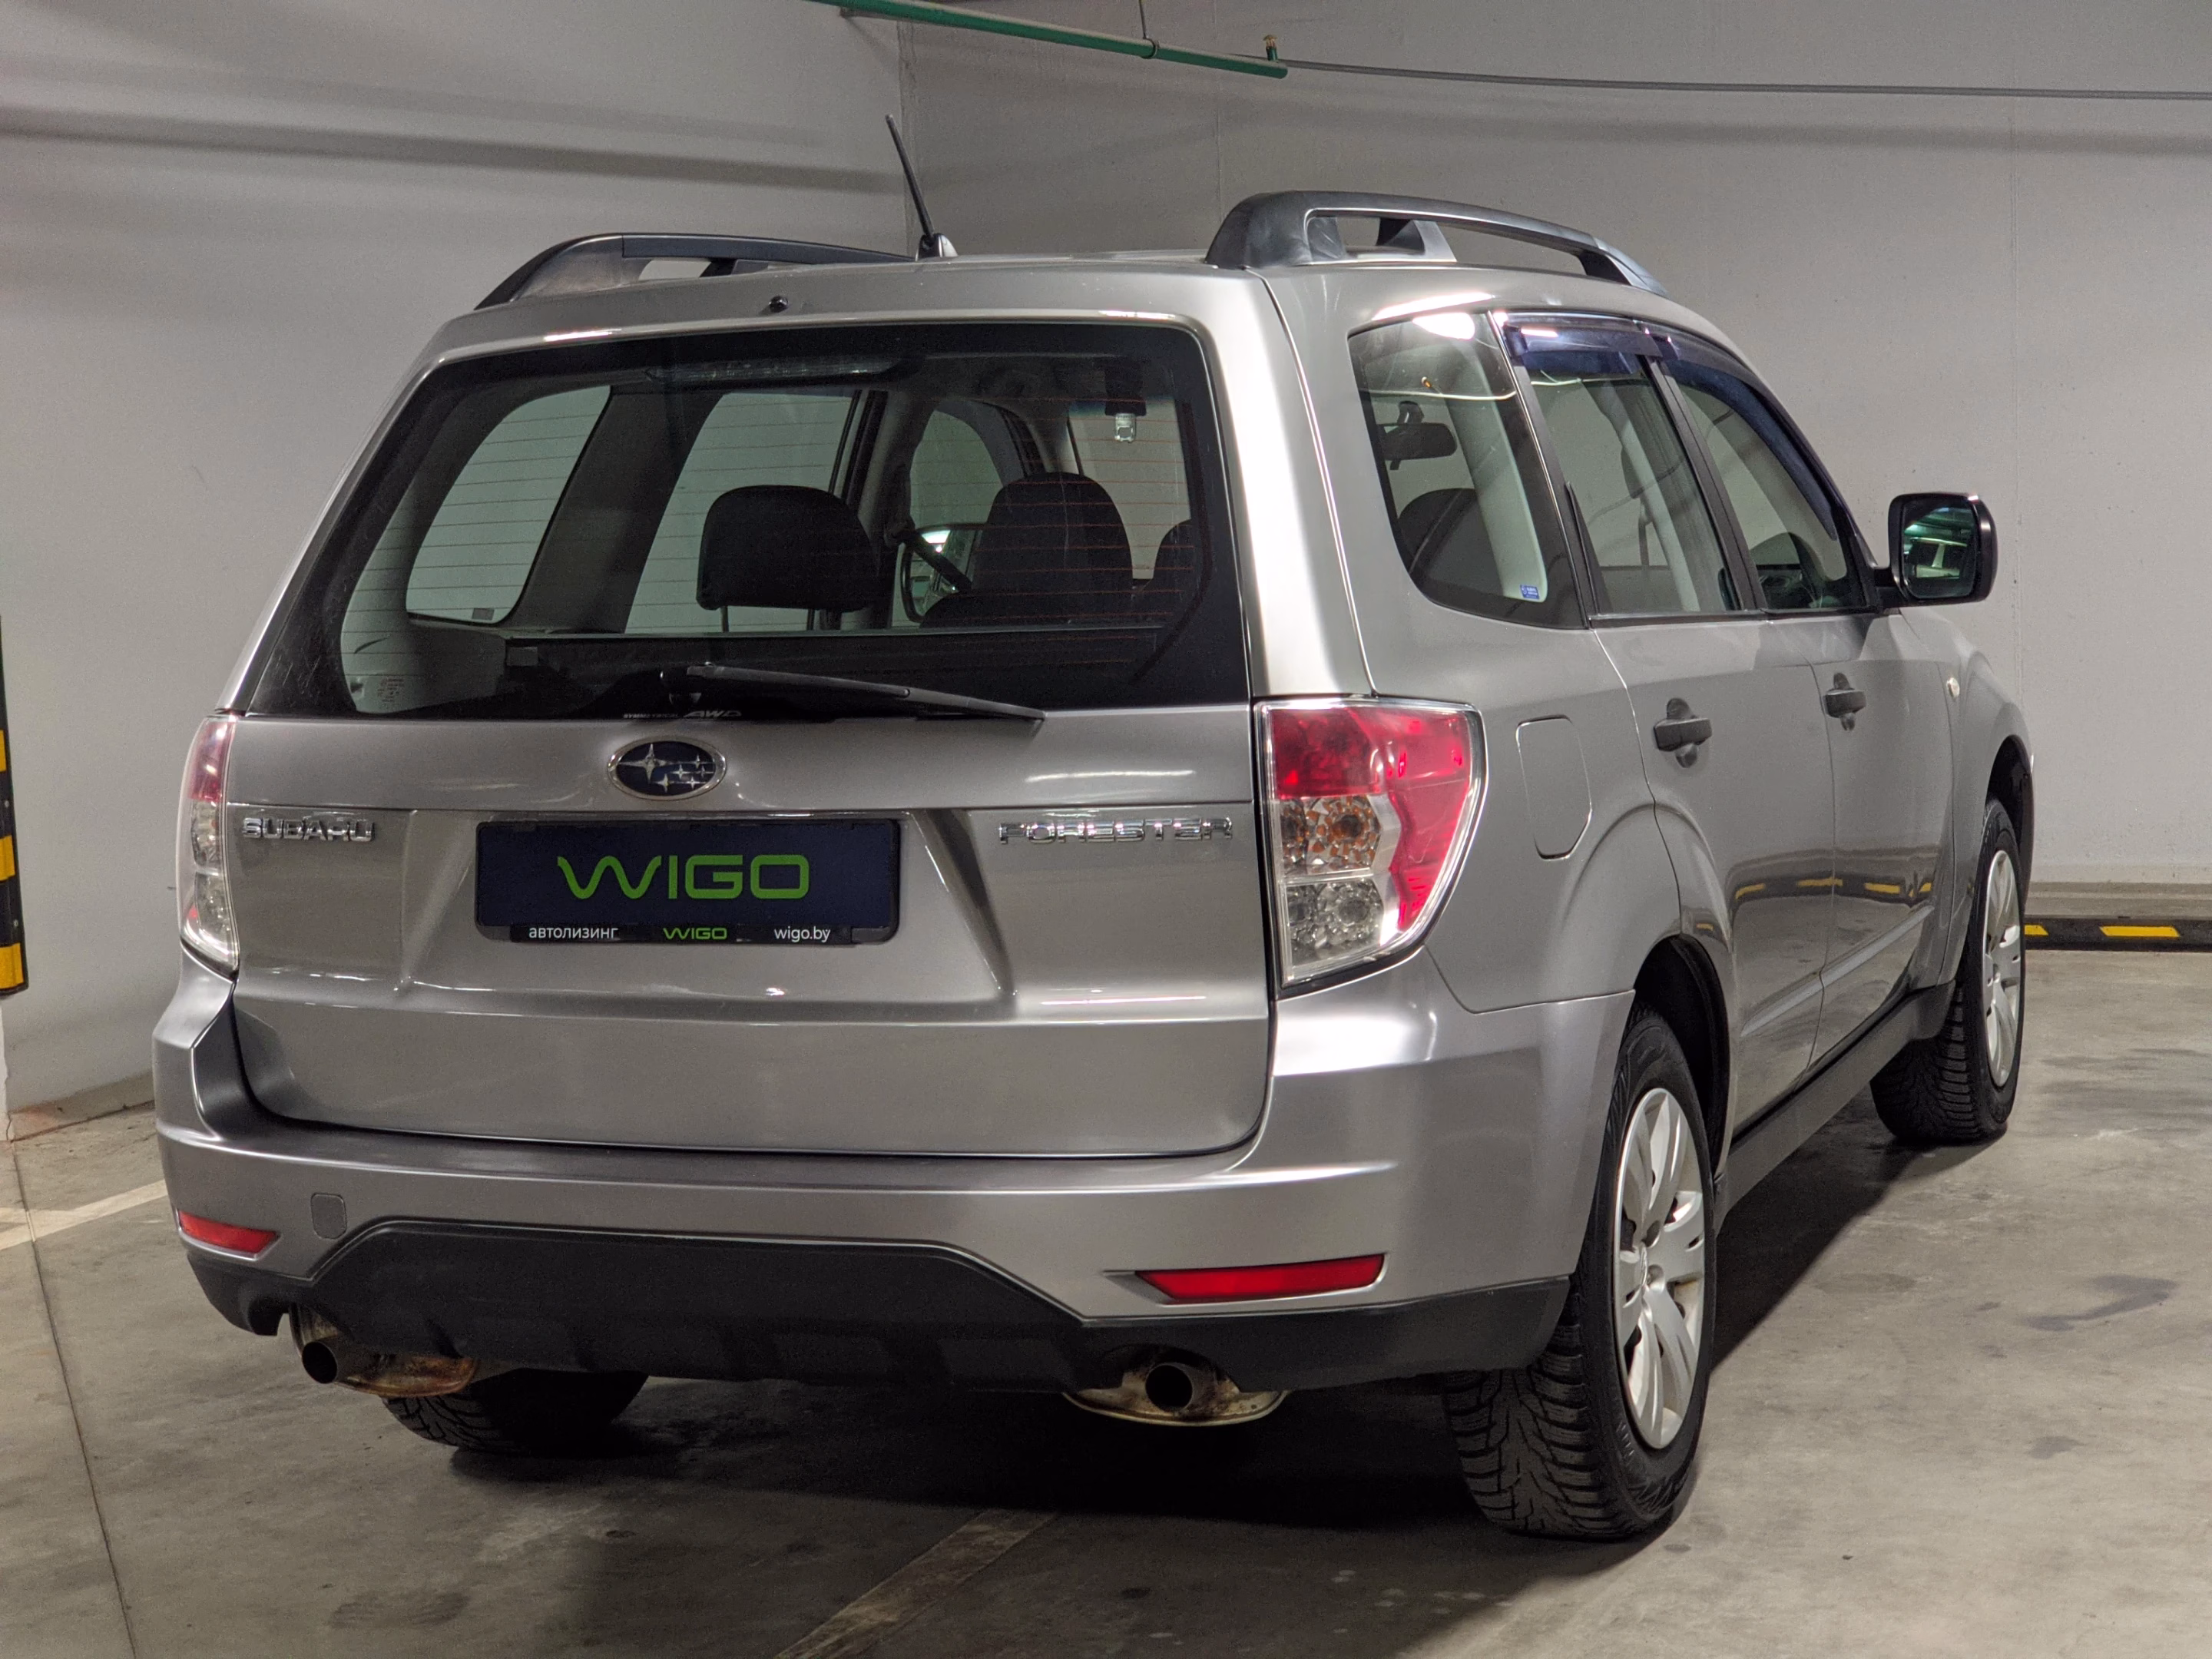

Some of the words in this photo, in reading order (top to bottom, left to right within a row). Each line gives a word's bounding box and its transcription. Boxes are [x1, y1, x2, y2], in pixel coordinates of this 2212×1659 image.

[683, 710, 742, 719] AWD
[243, 817, 376, 842] SUBARU
[999, 818, 1232, 844] FORESTER
[558, 854, 810, 899] WIGO
[528, 926, 618, 939] автолизинг
[663, 927, 727, 939] WIGO
[774, 926, 831, 942] wigo.by
